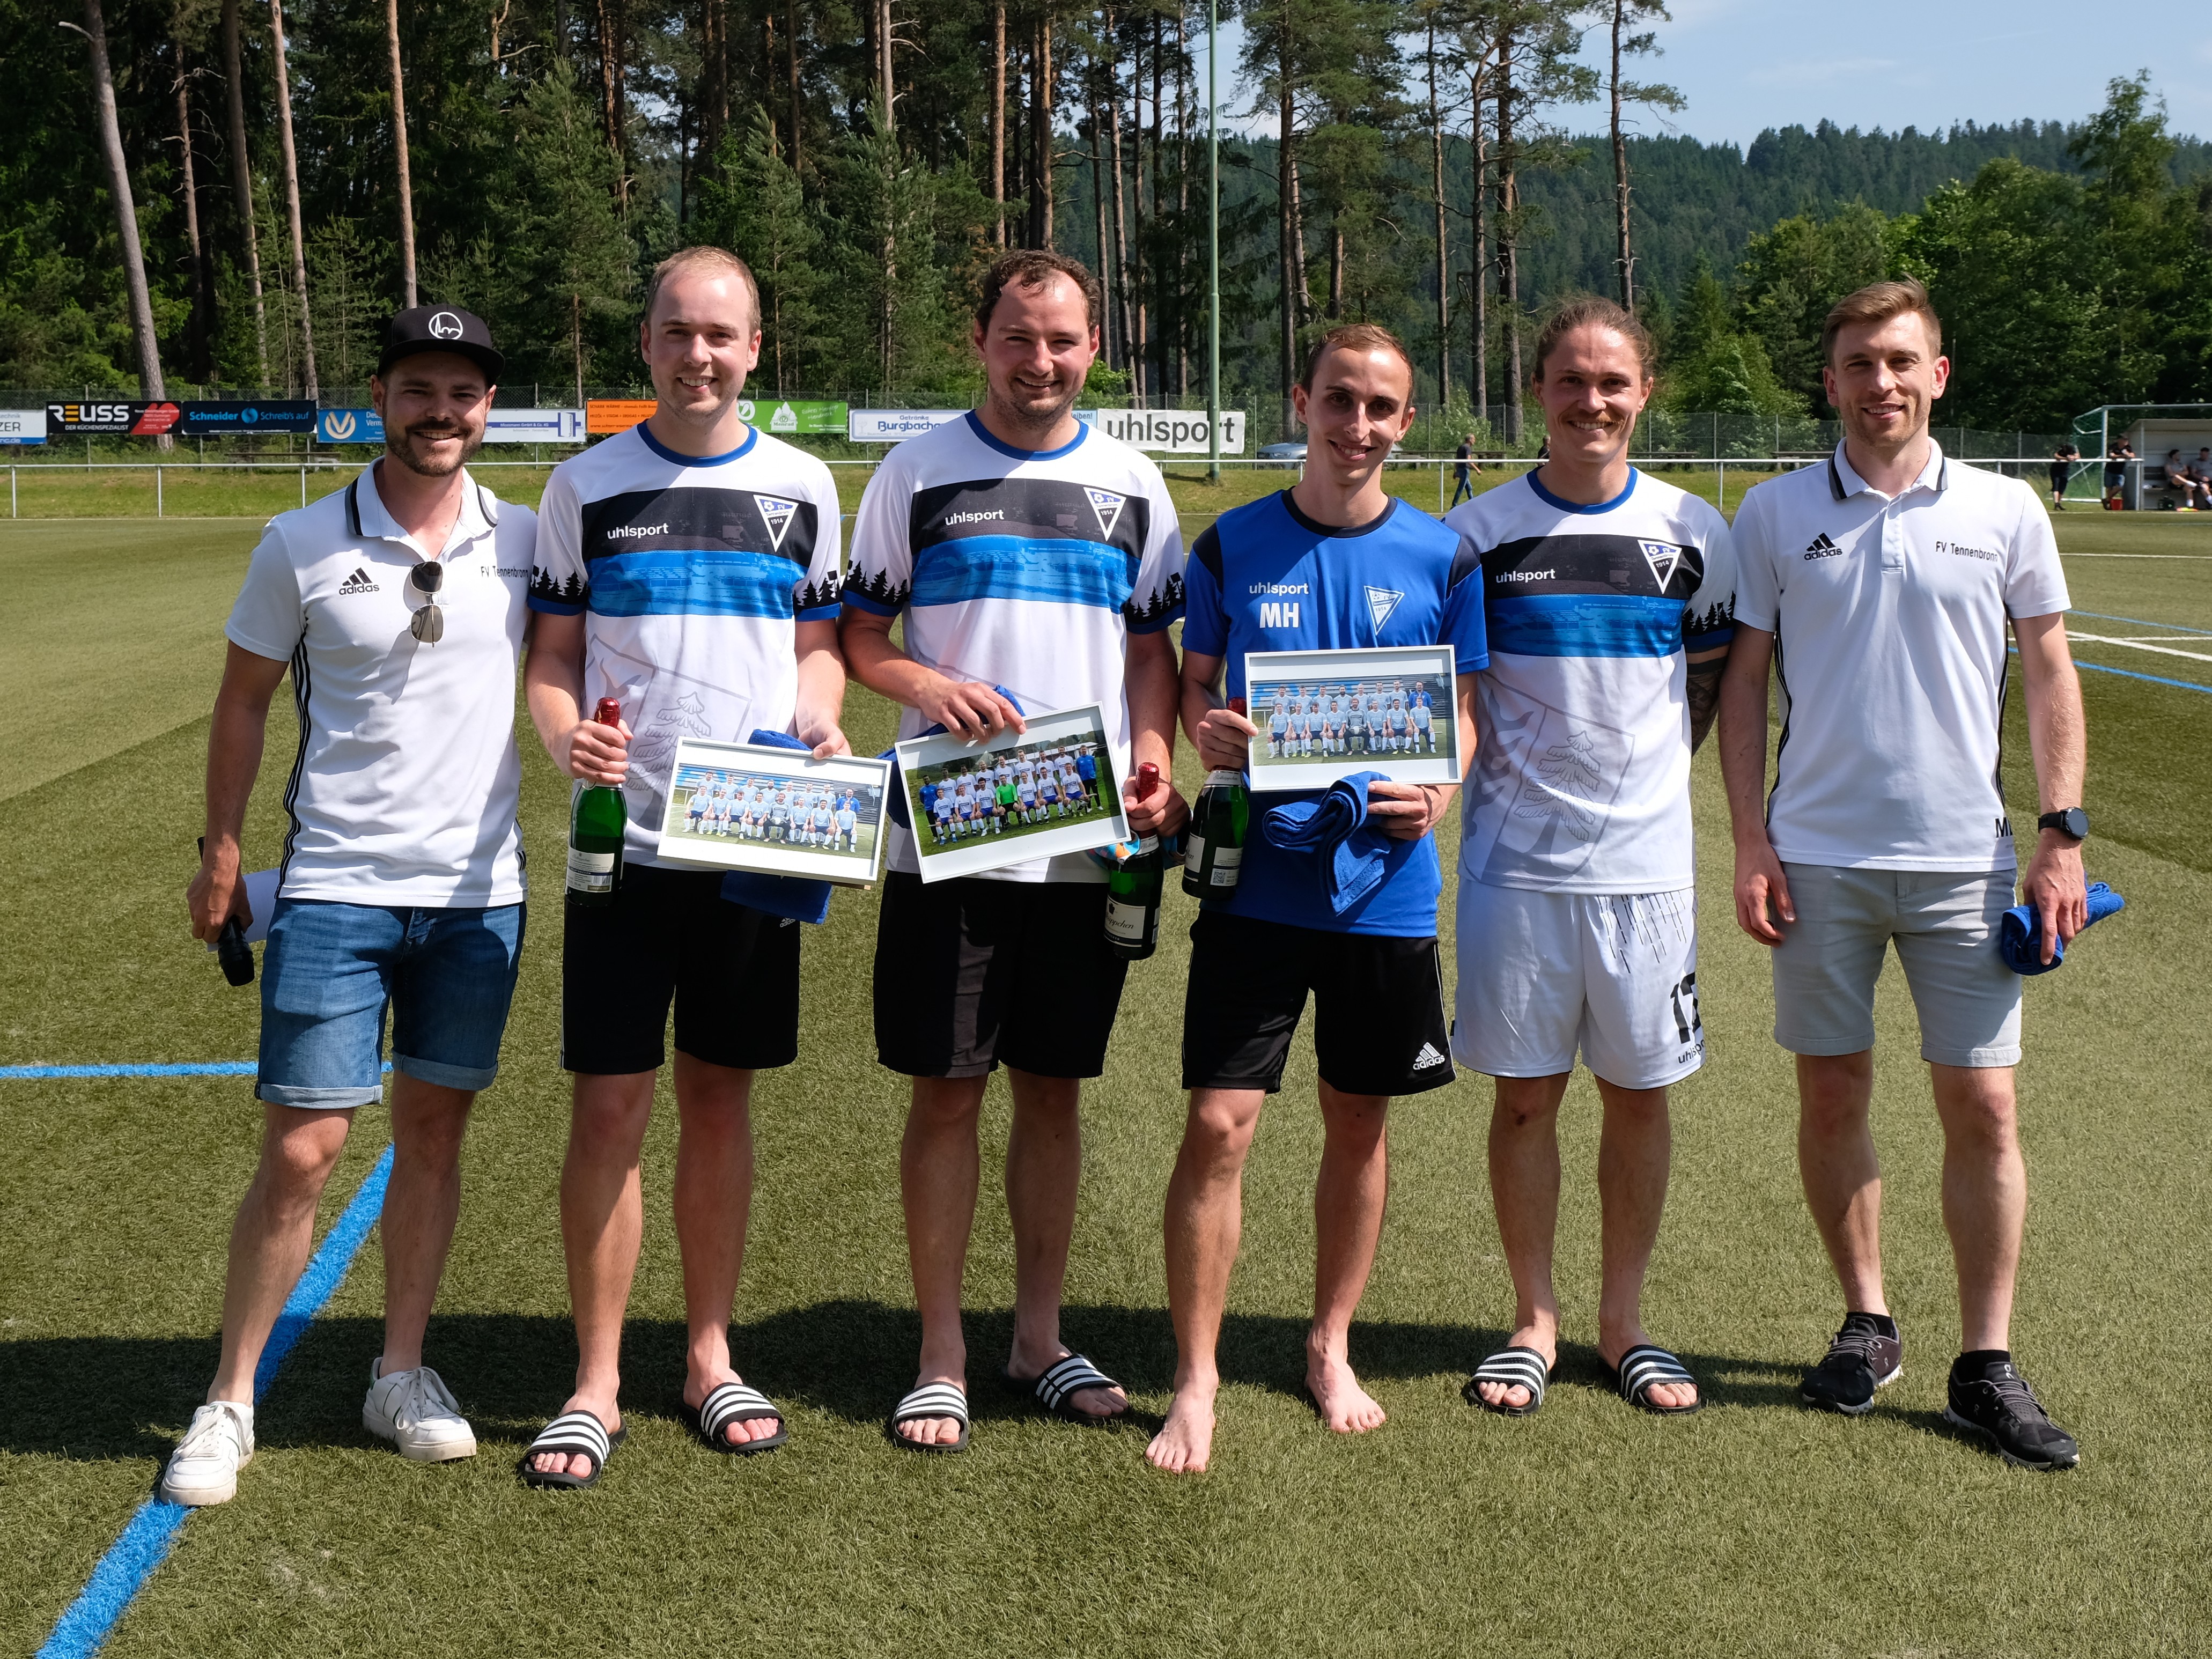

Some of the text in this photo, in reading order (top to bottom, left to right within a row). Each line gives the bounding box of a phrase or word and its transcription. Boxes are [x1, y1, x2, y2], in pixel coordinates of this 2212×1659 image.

[48, 405, 129, 422] REUSS
[189, 411, 238, 420] Schneider
[260, 411, 309, 420] Schreib's auf
[1107, 414, 1235, 448] uhlspot
[945, 508, 1005, 527] uhlsport
[607, 522, 669, 540] uhlsport
[1804, 547, 1842, 561] adidas
[1936, 541, 1999, 563] FV Tennenbronn
[1656, 560, 1670, 568] 1914
[481, 565, 528, 579] FV Tennenbronn
[1495, 567, 1555, 584] uhlsport
[339, 583, 380, 595] adidas
[1249, 582, 1309, 595] uhlsport
[1259, 602, 1299, 629] MH
[1413, 1055, 1446, 1070] adidas
